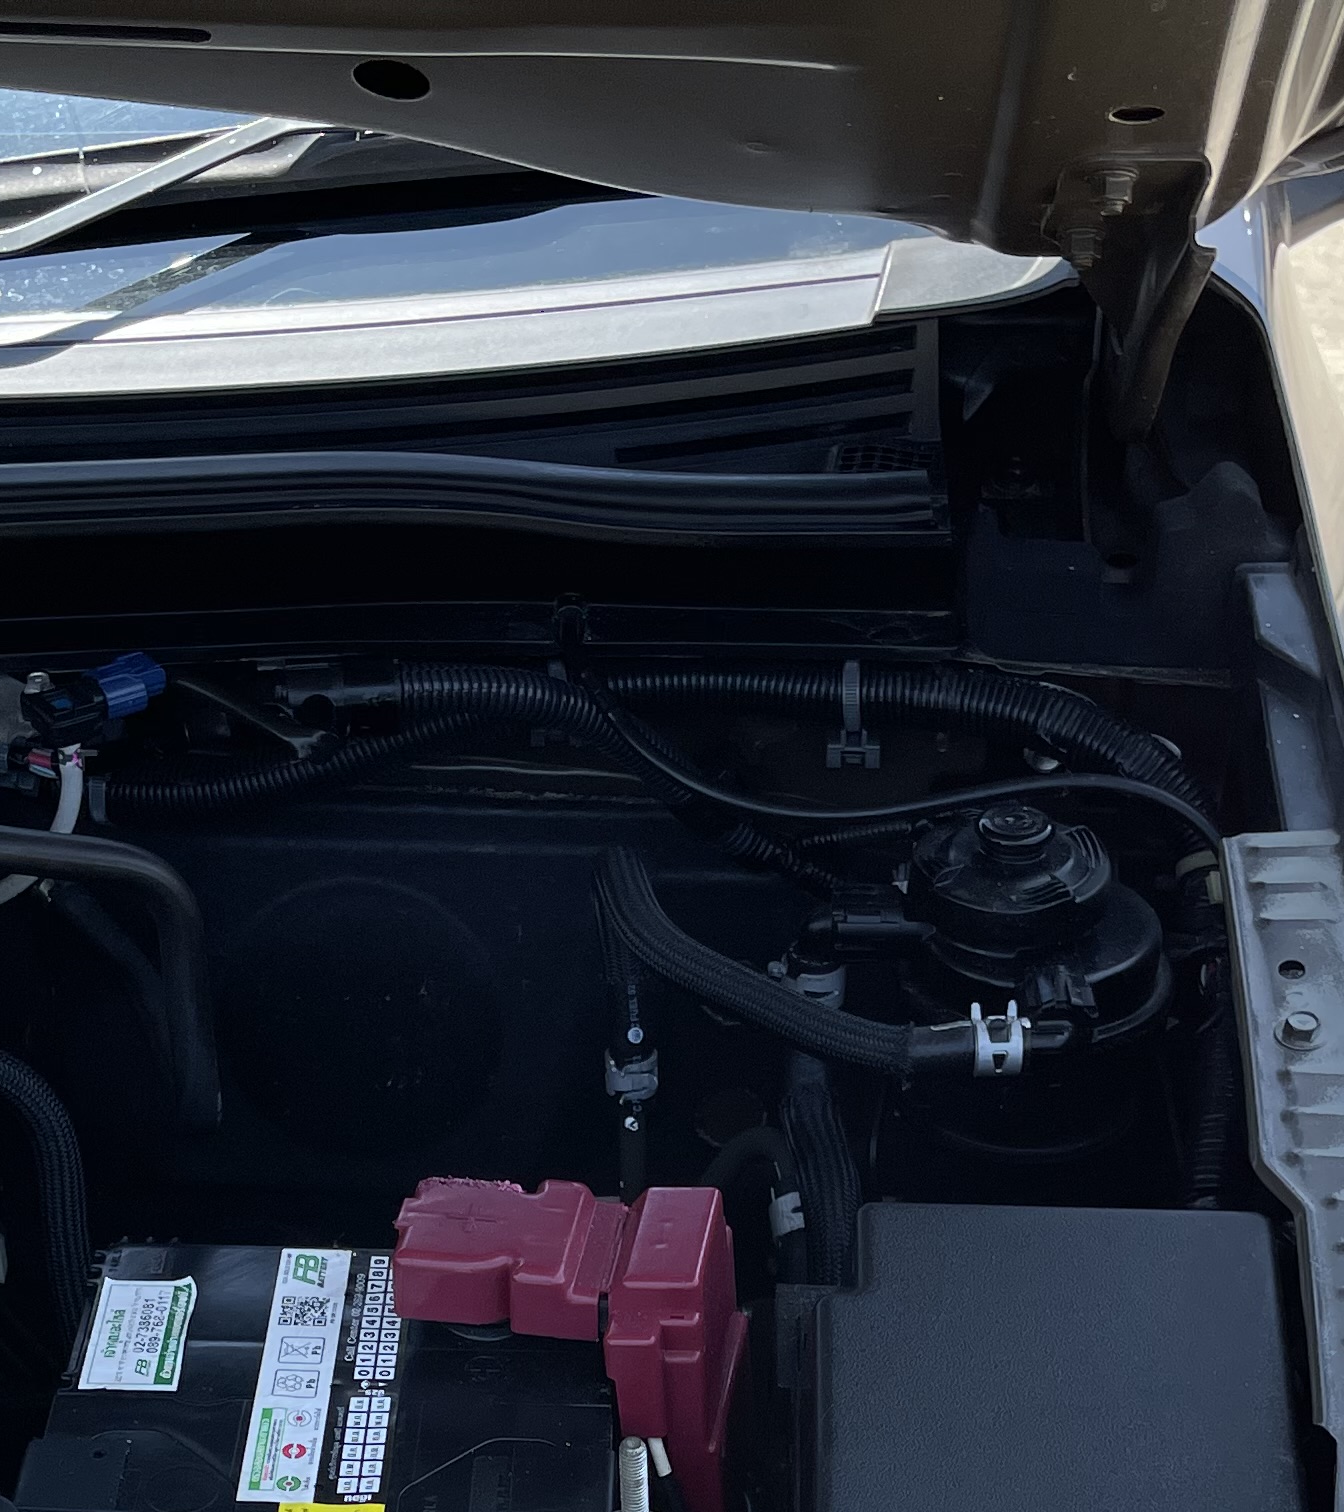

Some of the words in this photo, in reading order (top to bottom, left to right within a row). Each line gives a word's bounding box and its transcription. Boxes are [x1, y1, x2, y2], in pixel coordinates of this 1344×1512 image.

[346, 1318, 359, 1344] Center
[312, 1345, 322, 1356] Pb
[344, 1346, 356, 1362] Call
[306, 1378, 317, 1389] Pb
